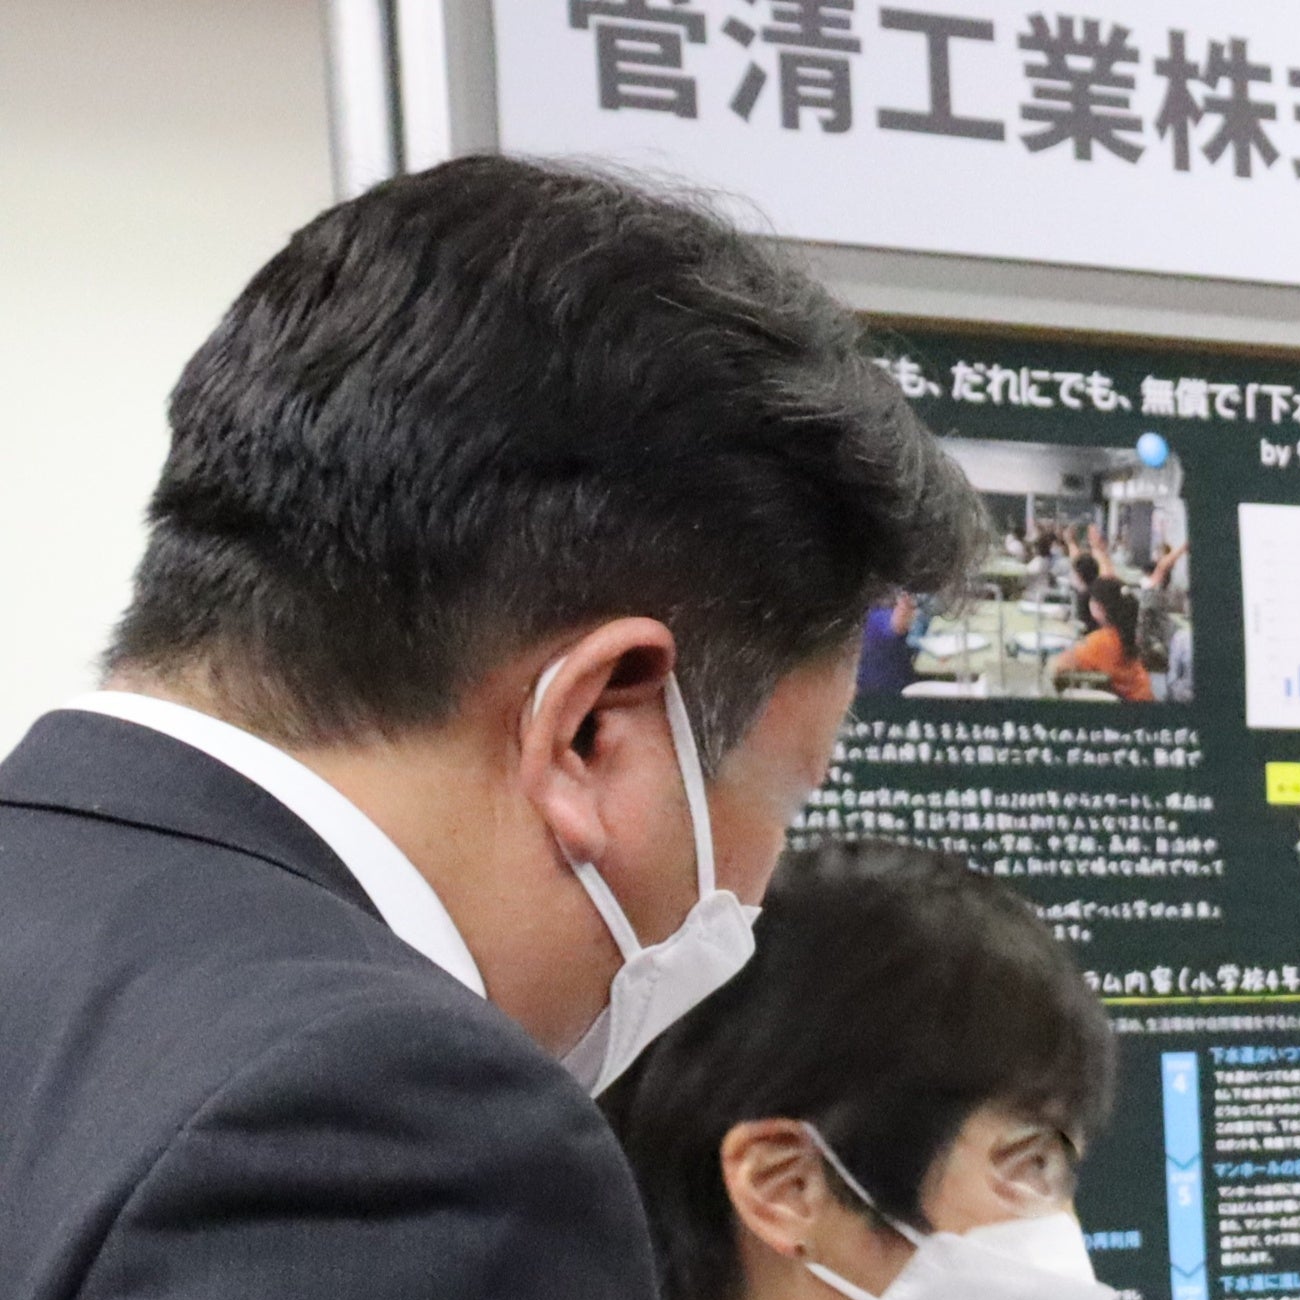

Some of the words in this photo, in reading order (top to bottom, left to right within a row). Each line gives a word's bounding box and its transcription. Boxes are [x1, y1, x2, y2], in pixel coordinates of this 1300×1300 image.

[1260, 438, 1290, 468] by
[1173, 1074, 1187, 1094] 4
[1178, 1186, 1191, 1206] 5
